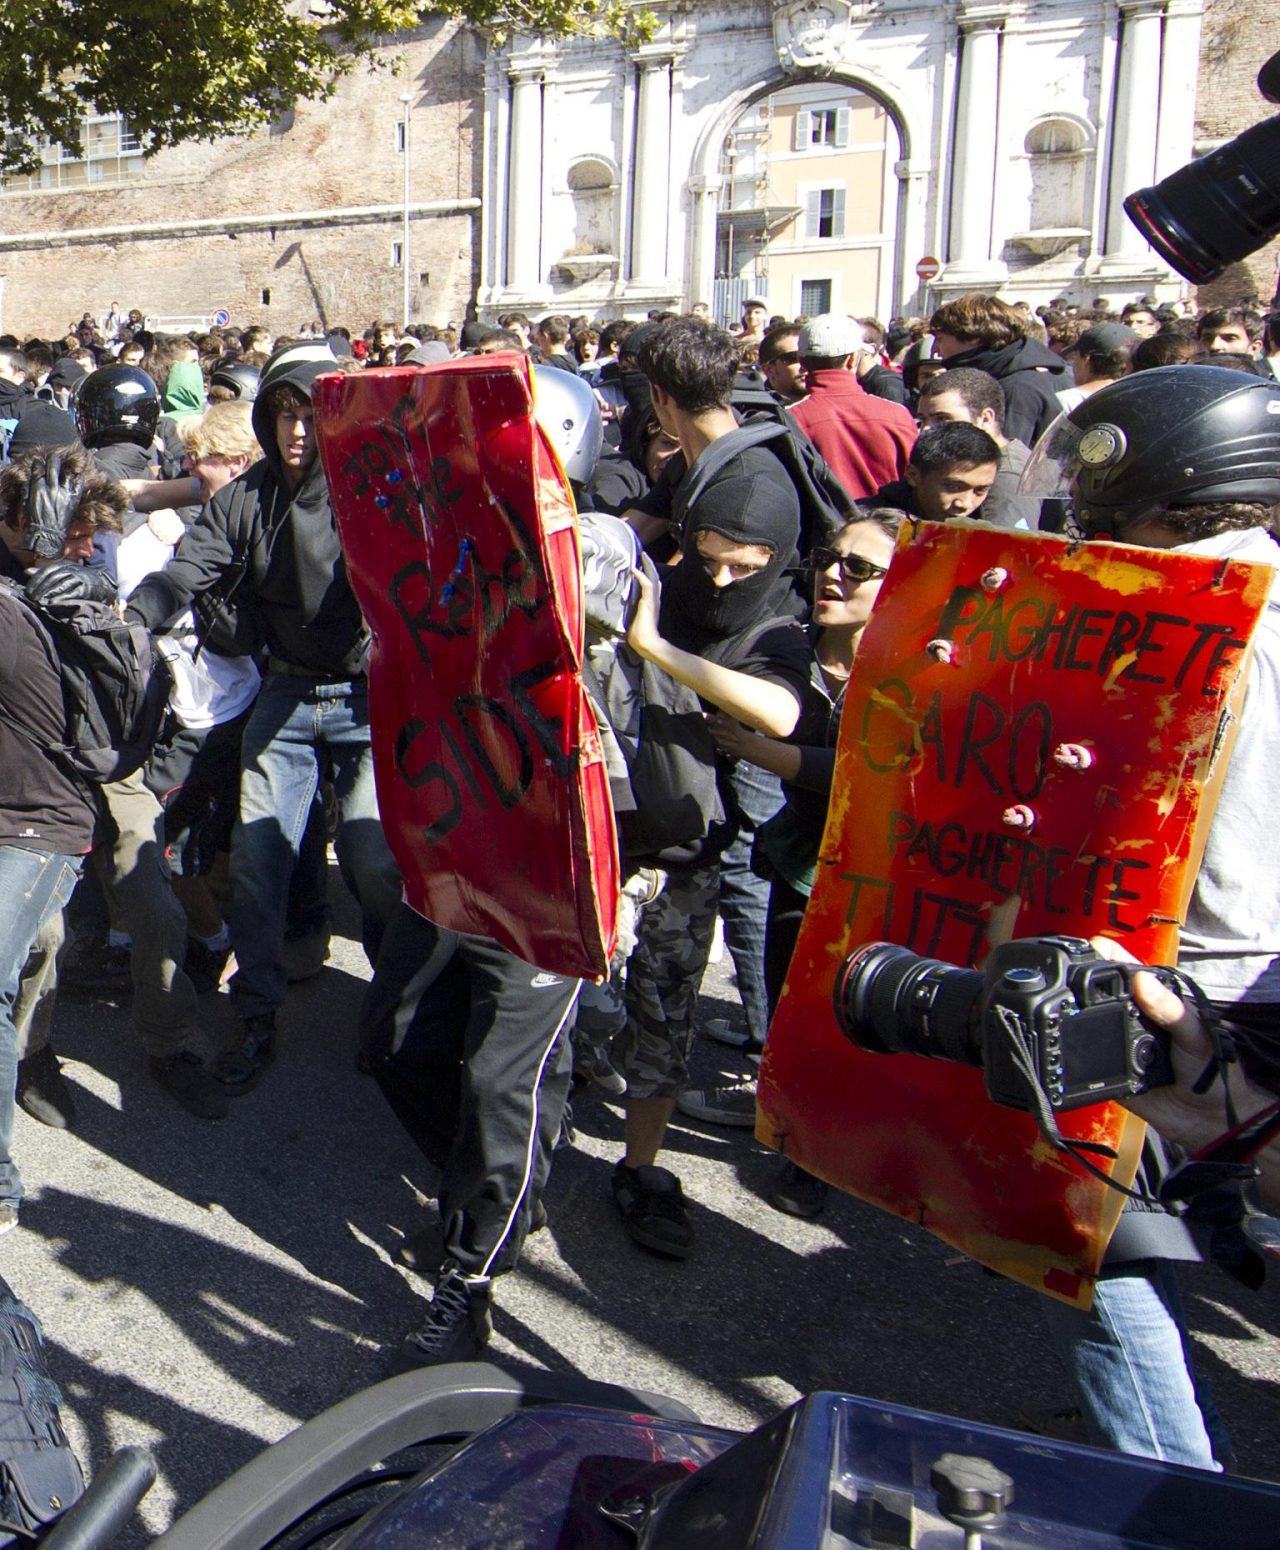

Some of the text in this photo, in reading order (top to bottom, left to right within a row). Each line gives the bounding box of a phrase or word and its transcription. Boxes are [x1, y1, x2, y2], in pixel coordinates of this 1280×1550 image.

[936, 585, 1247, 696] PAGHERETE
[396, 661, 580, 845] SIDE
[862, 677, 1053, 803] CARO
[839, 872, 996, 967] TUTT
[887, 809, 1151, 932] PAGHERETE
